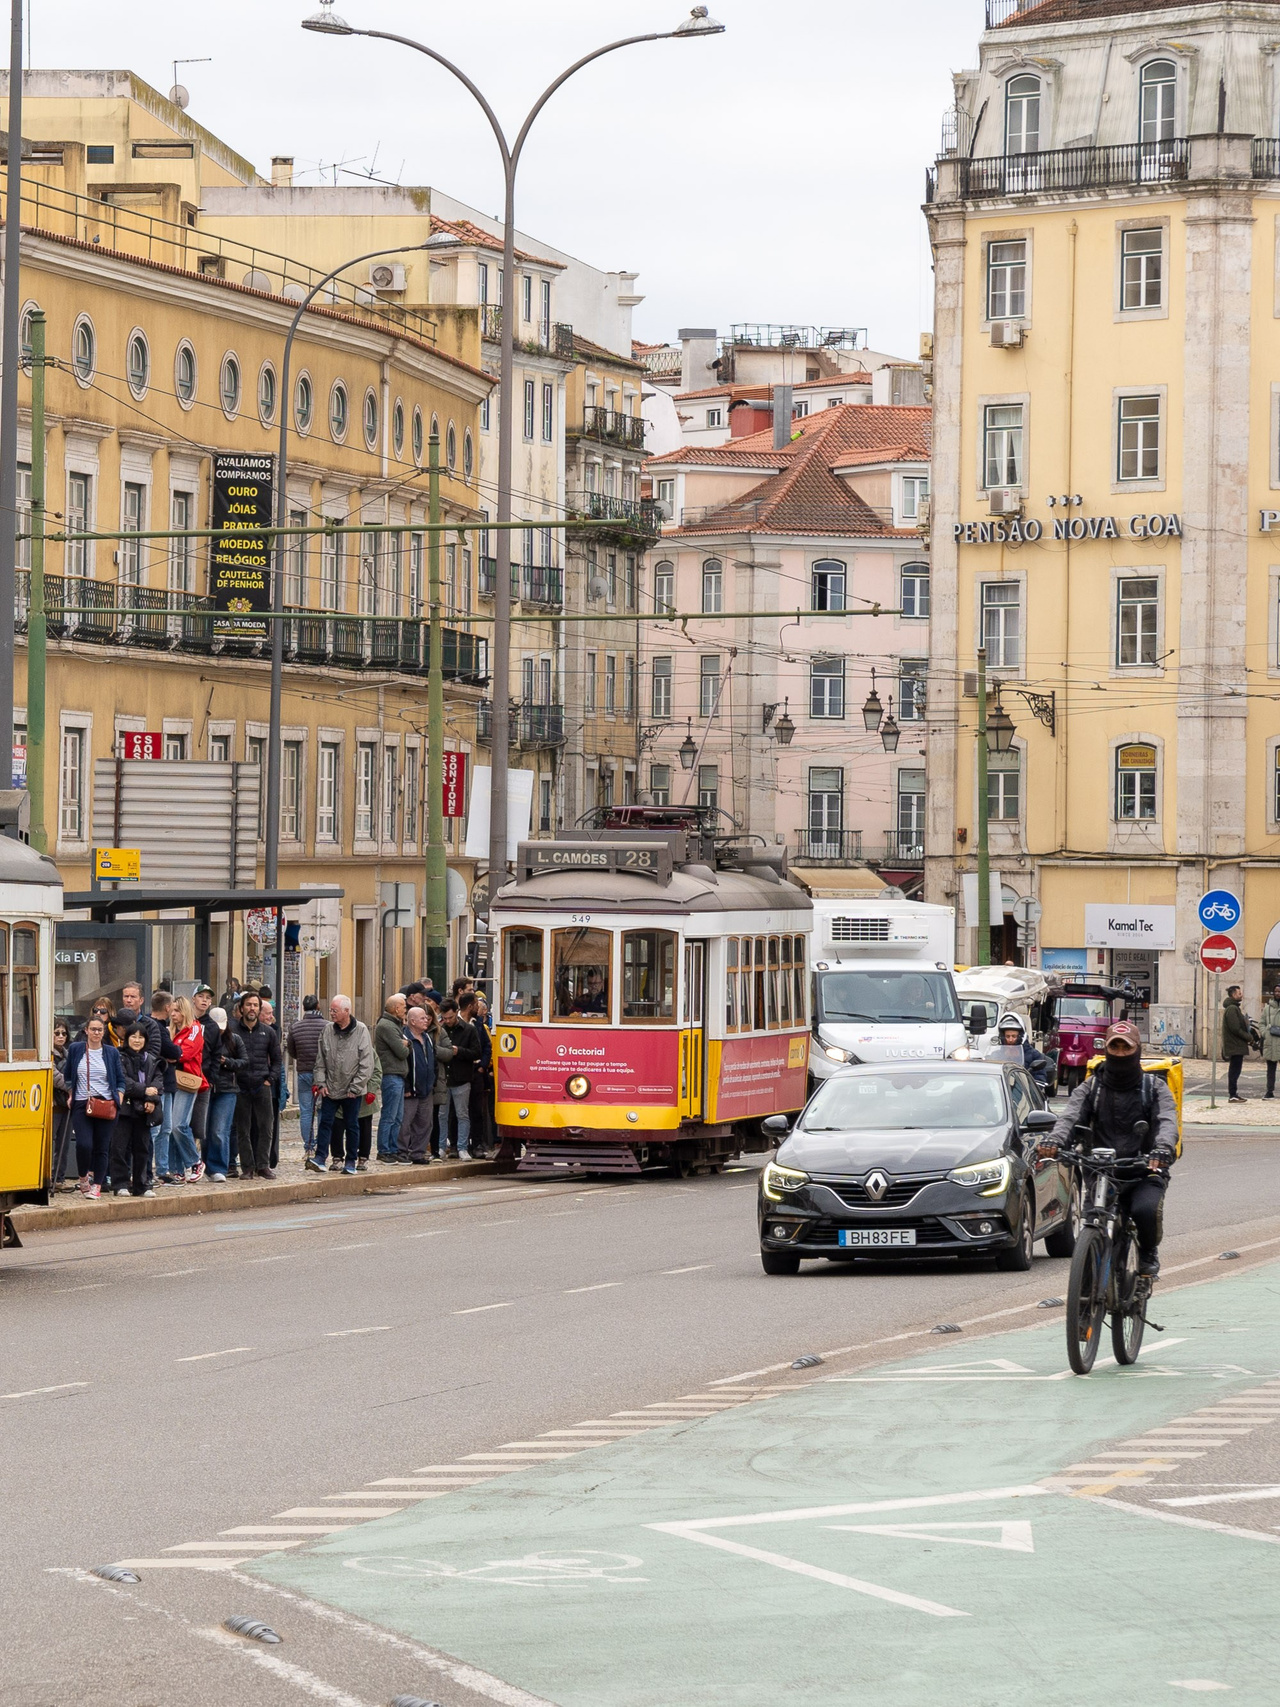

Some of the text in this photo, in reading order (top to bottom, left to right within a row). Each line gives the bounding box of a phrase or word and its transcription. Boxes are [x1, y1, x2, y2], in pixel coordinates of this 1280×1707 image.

[217, 457, 271, 469] AVALIAMOS
[216, 470, 271, 480] COMPRAMOS
[228, 486, 258, 497] OURO
[228, 502, 257, 514] JÓIAS
[223, 521, 261, 530] PRATAS
[952, 514, 1182, 543] PENSÃO NOVA GOA
[219, 539, 263, 549] MOEDAS
[216, 553, 266, 566] RELÓGIOS
[219, 570, 262, 580] CAUTELAS
[217, 580, 264, 589] DE PENHOR
[537, 852, 549, 863] L.
[626, 851, 651, 867] 28
[572, 915, 591, 923] 549
[1108, 919, 1153, 931] Kamal Tec
[74, 952, 96, 963] EV3
[1115, 953, 1127, 961] ISTO
[1133, 953, 1146, 961] REAL
[569, 1047, 605, 1056] factorial
[886, 1048, 925, 1058] IVECO
[2, 1081, 26, 1109] carris
[850, 1231, 910, 1244] BH83FE
